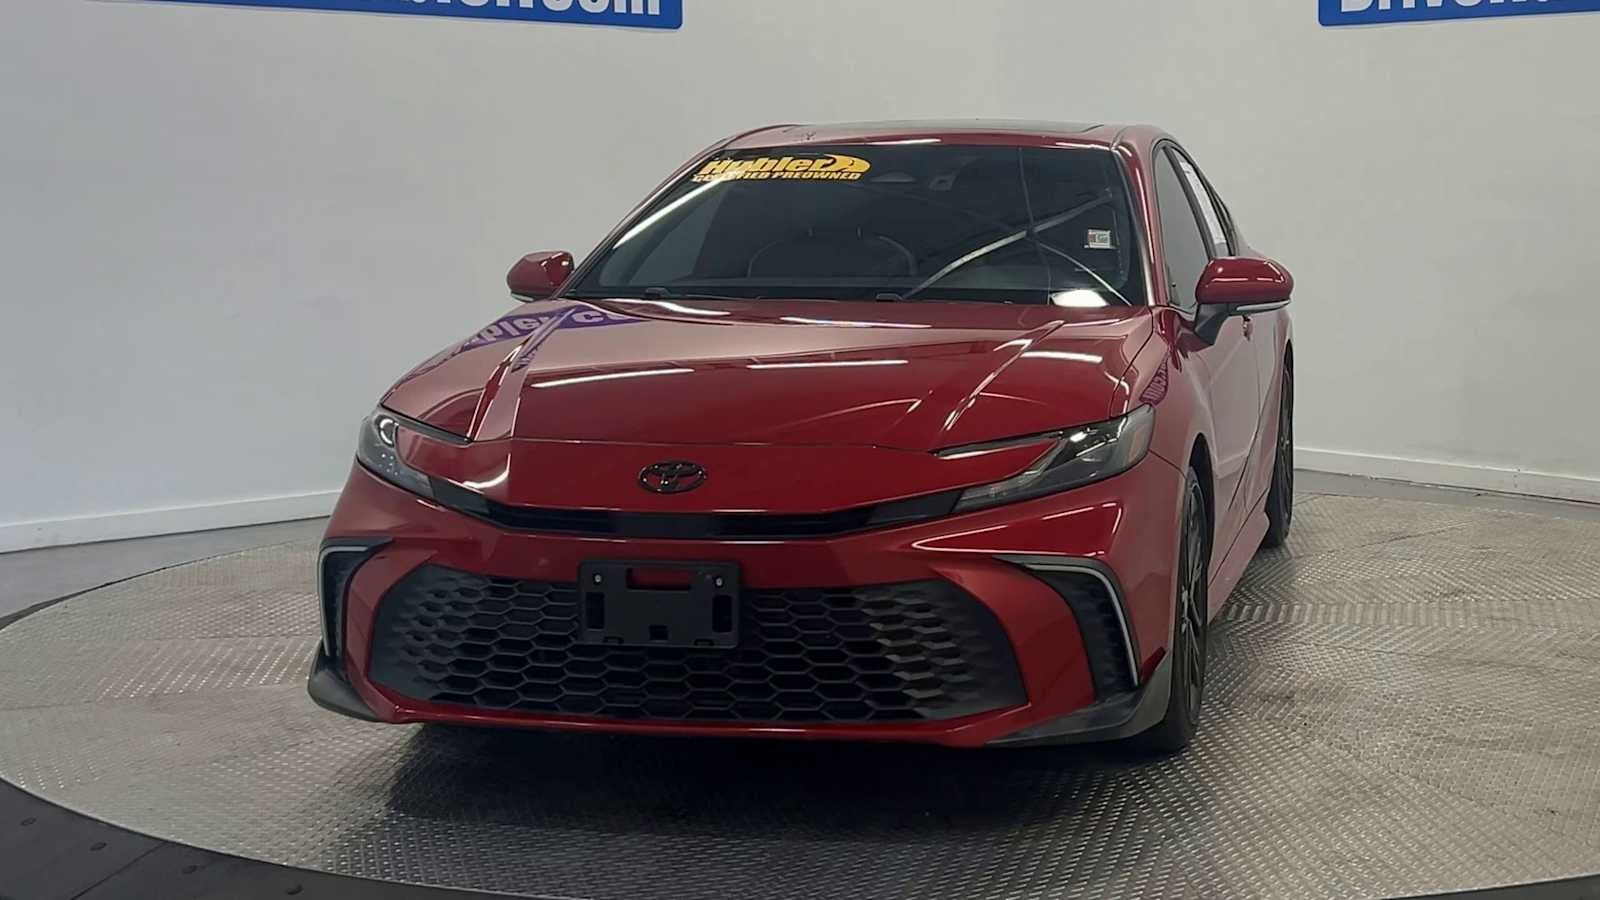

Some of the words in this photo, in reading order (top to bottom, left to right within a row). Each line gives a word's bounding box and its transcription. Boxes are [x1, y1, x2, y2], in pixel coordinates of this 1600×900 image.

[697, 156, 837, 175] Hubler
[691, 171, 771, 182] CEFIED
[771, 170, 862, 180] PREOWNED
